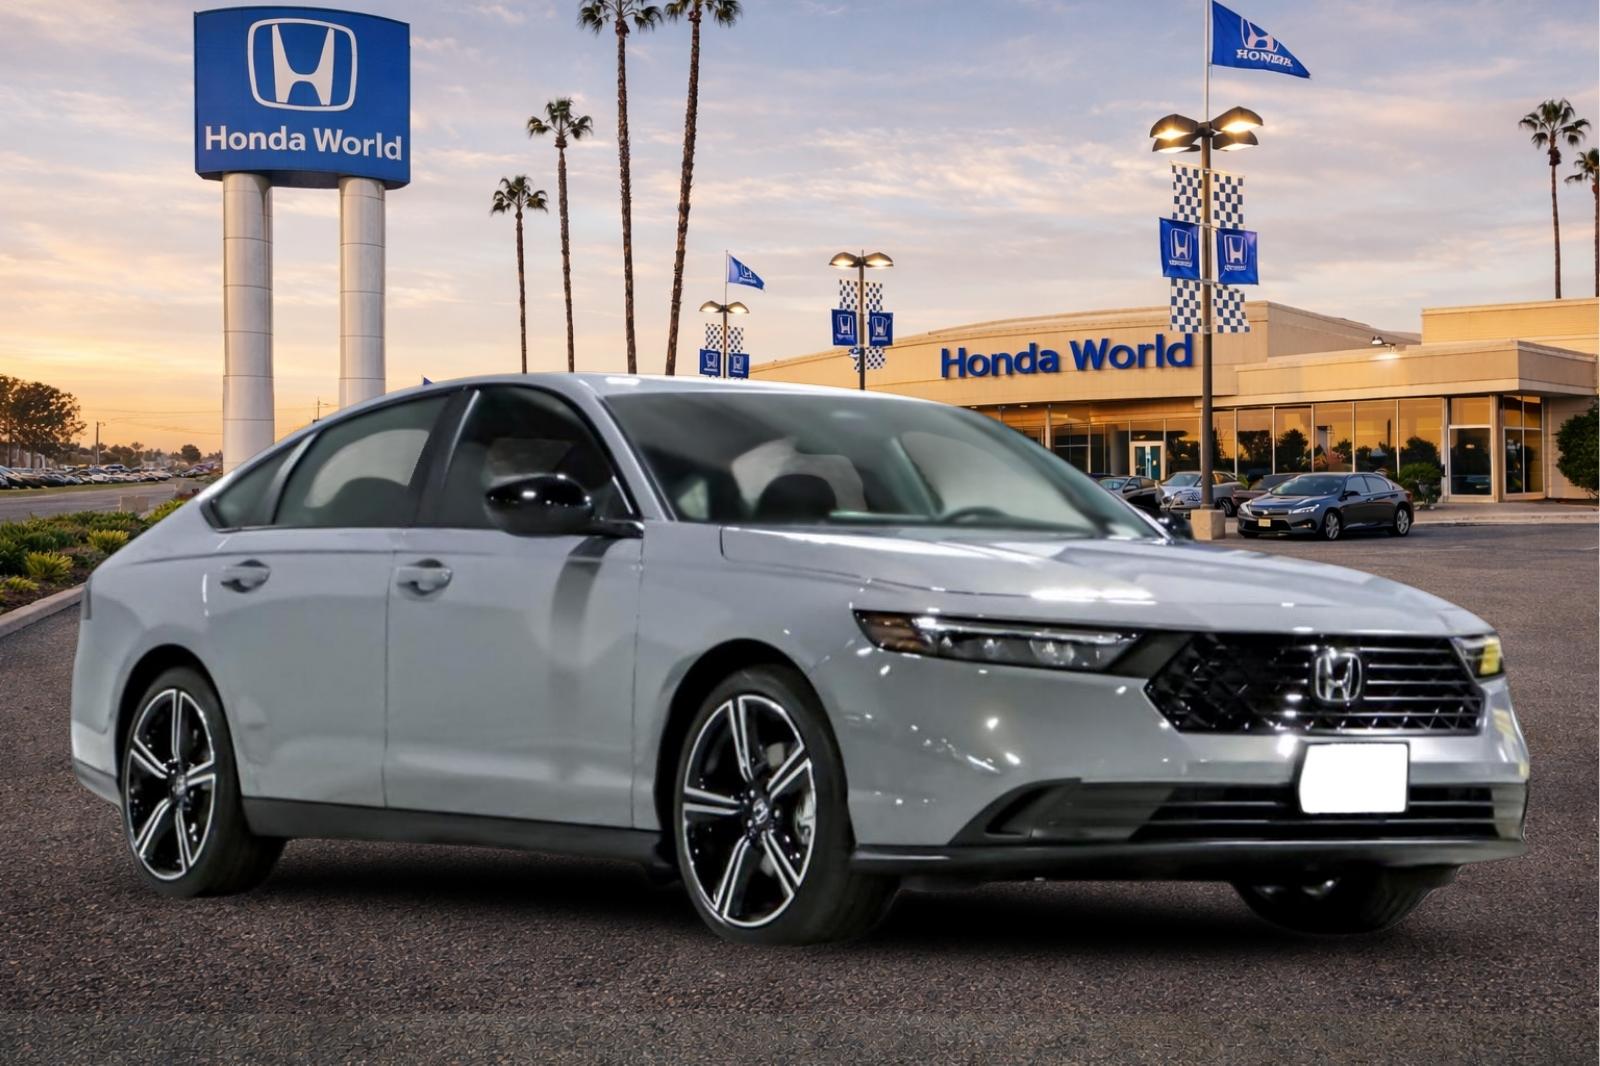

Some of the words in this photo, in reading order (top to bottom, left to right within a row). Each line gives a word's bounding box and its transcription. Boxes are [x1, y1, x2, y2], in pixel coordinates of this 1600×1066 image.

[205, 125, 306, 151] Honda
[313, 127, 402, 161] World
[941, 342, 1061, 378] Honda
[1070, 333, 1194, 371] World
